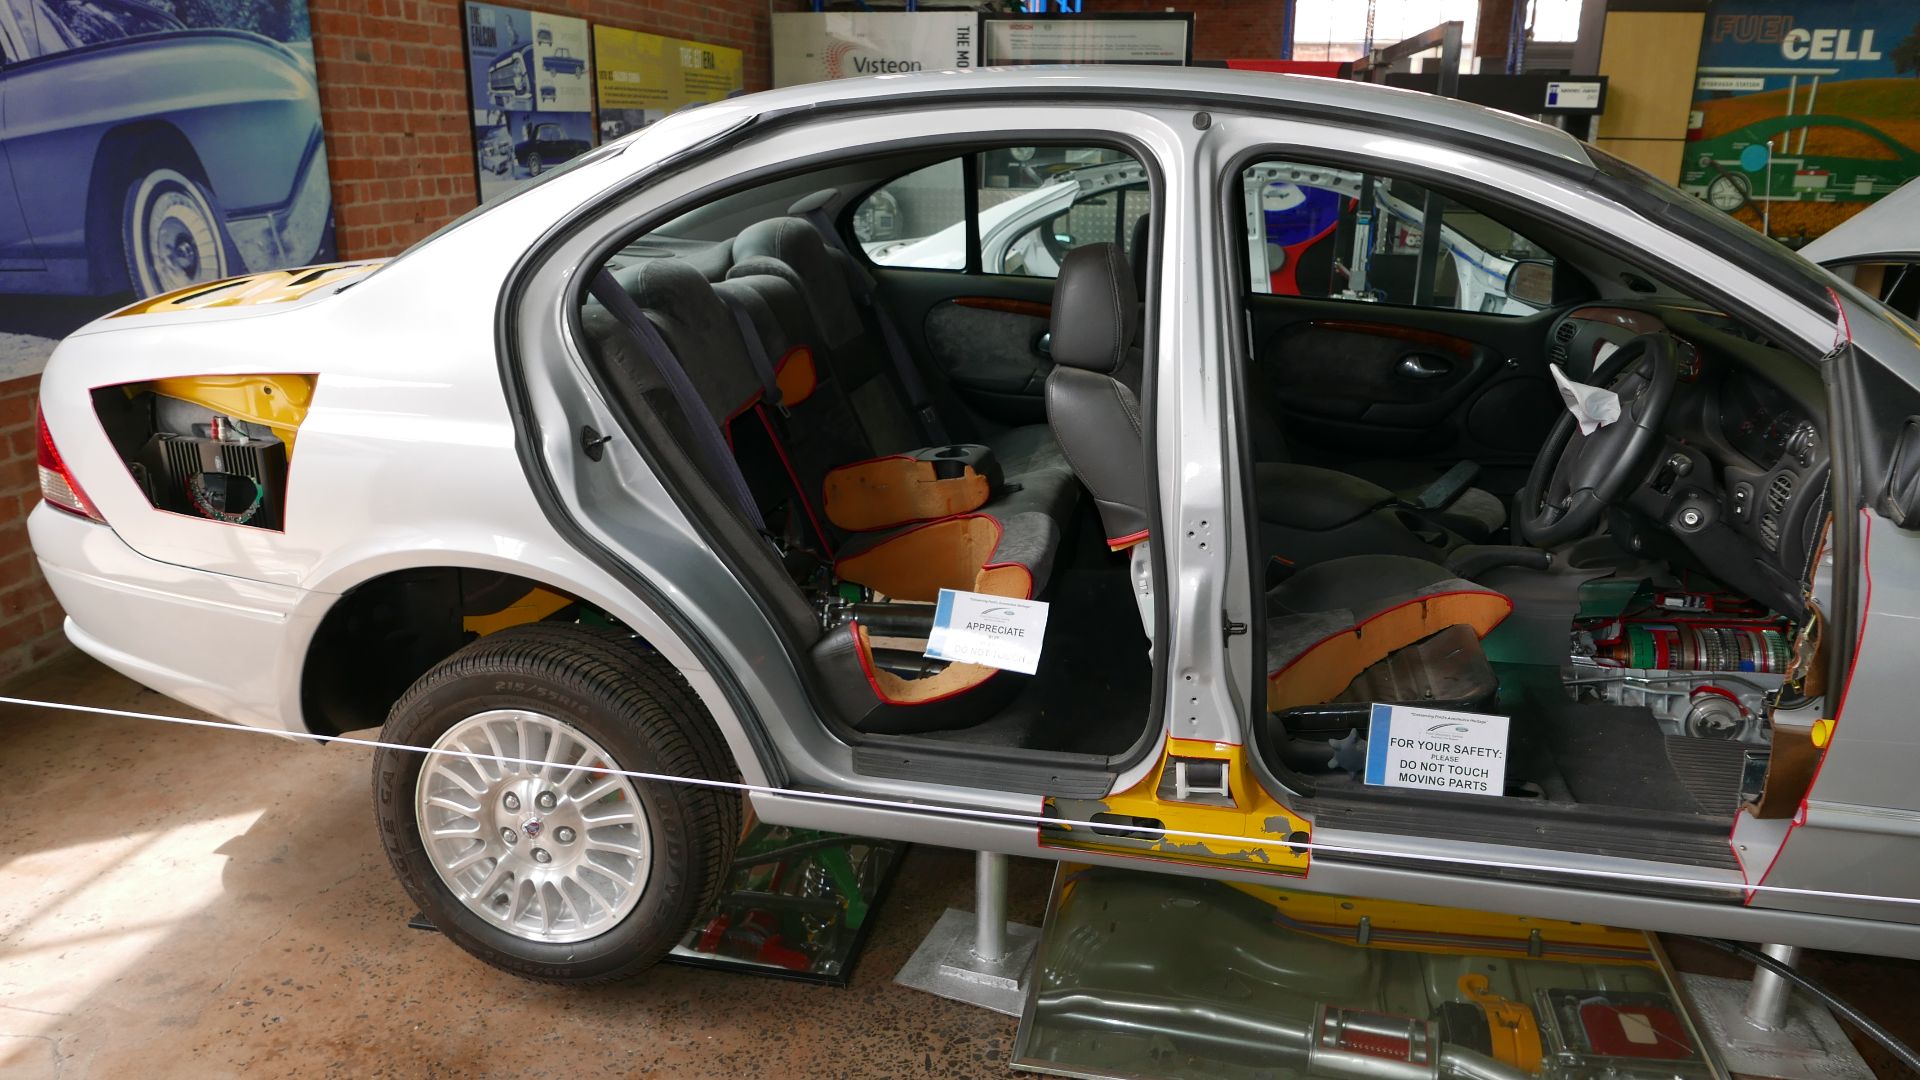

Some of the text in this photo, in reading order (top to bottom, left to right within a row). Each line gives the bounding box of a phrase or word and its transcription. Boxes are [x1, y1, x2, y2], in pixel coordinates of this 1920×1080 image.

[471, 25, 497, 47] FALCON
[957, 27, 970, 47] THE
[1712, 15, 1801, 44] FUEL
[1782, 28, 1882, 60] CELL
[703, 51, 716, 70] ERA
[853, 56, 922, 74] Visteon
[965, 621, 1025, 638] APPRECIATE
[1390, 737, 1415, 749] FOR
[1418, 740, 1450, 753] YOUR
[1454, 744, 1503, 759] SAFETY:
[1430, 753, 1460, 763] PLEASE
[1400, 759, 1489, 778] DO NOT TOUCH
[1398, 772, 1488, 792] MOVING PARTS
